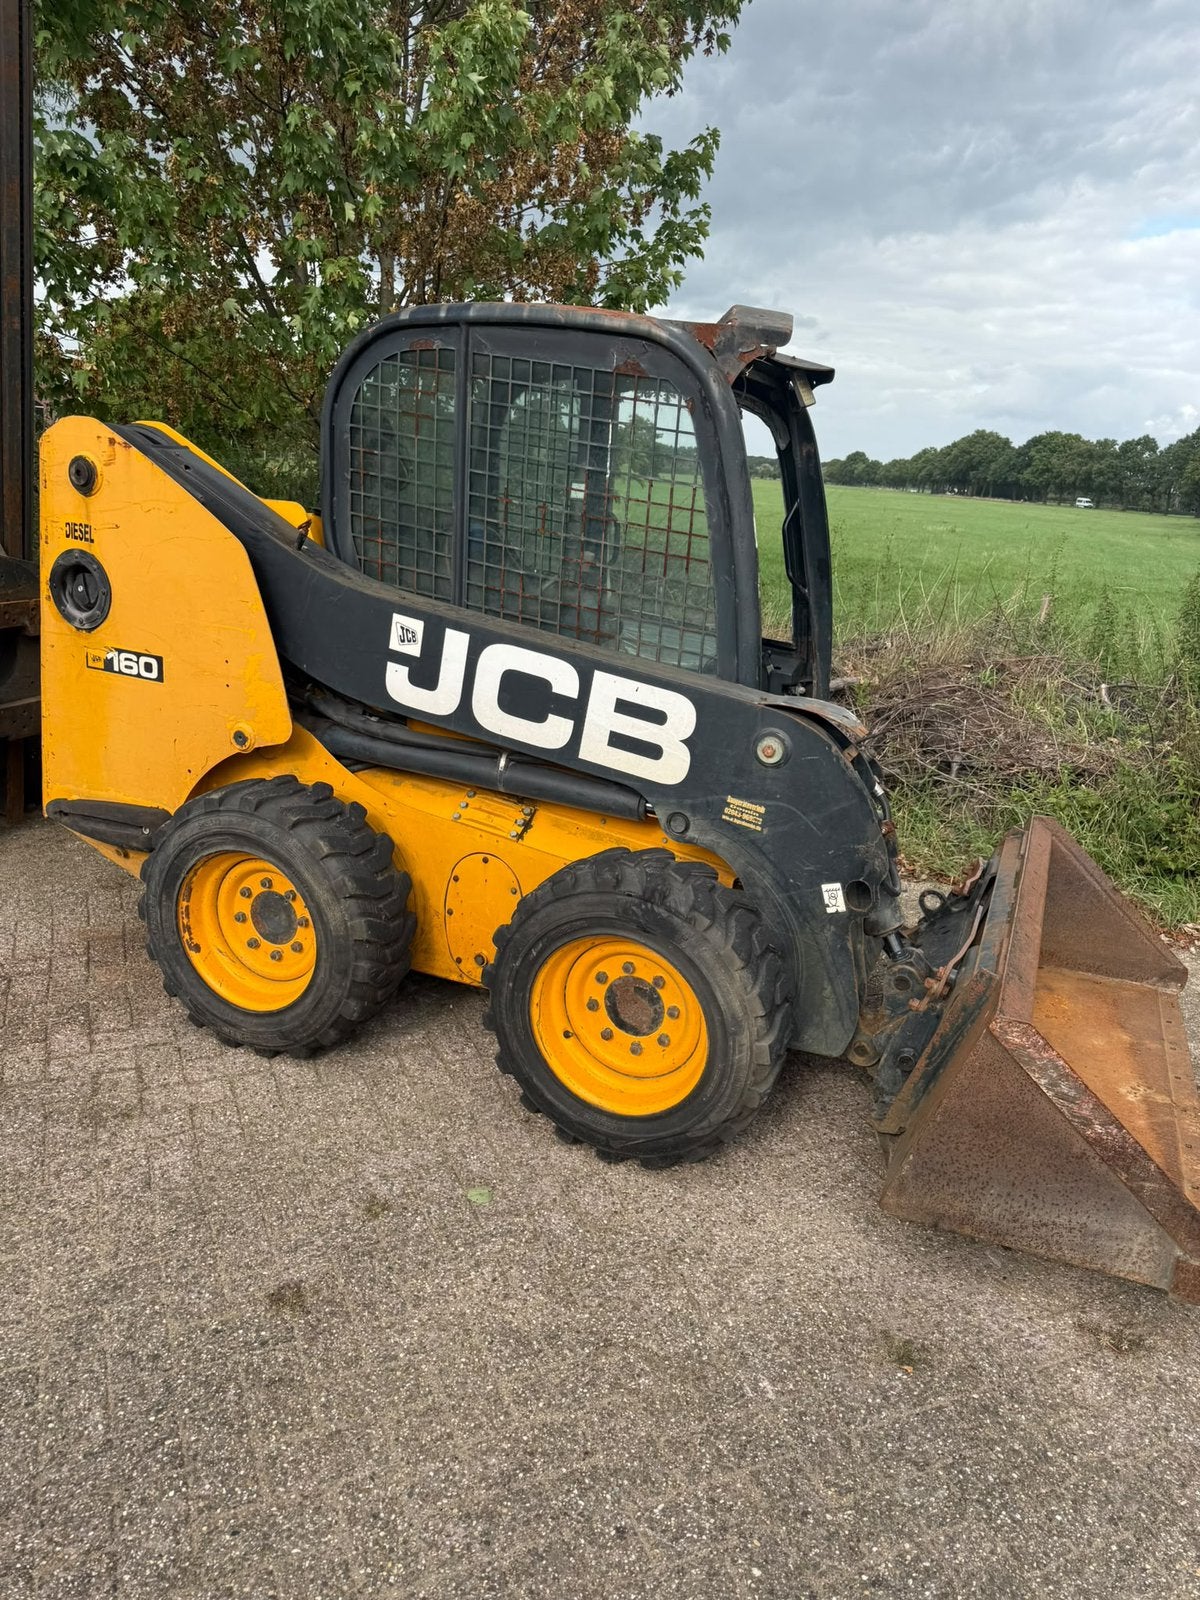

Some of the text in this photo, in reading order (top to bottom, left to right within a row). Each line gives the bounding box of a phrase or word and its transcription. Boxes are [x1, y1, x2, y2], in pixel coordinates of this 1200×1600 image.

[65, 522, 95, 544] DIESEL
[399, 624, 418, 644] JCB
[106, 650, 159, 679] 160
[385, 627, 697, 785] JCB
